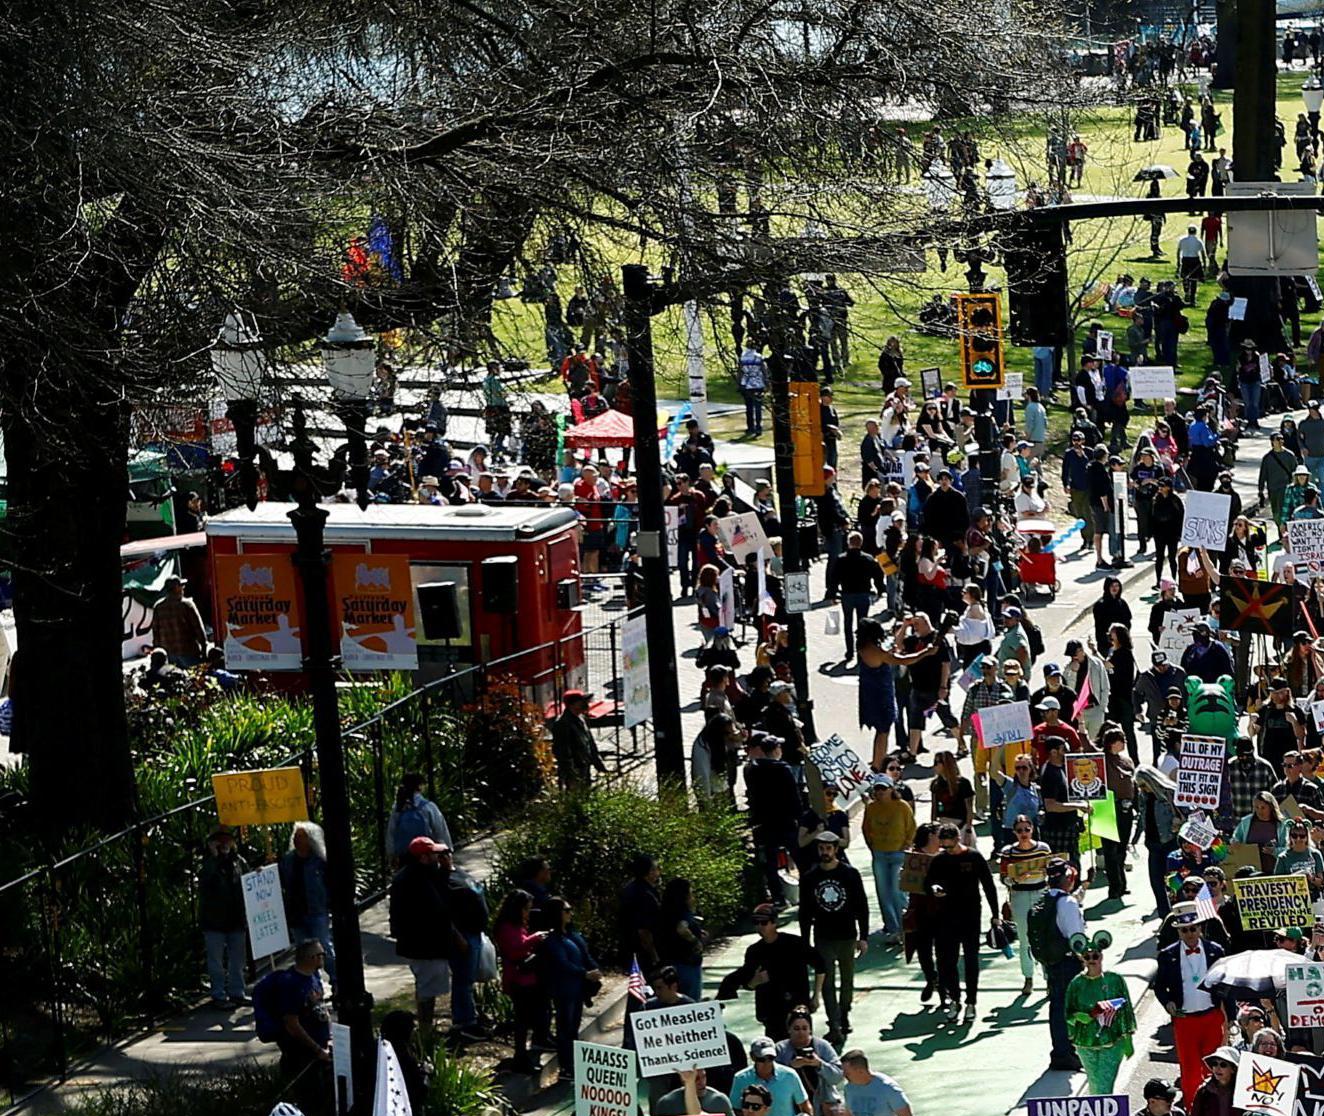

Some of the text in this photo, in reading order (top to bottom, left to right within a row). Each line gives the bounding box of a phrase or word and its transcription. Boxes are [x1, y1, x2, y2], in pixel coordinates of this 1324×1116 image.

[1183, 743, 1223, 757] ALL OF MY
[1181, 758, 1222, 771] OUTRAGE
[1180, 772, 1219, 784] CAN'T FIT ON
[1179, 782, 1218, 796] THIS SIGN
[636, 1007, 715, 1031] Got Measles?
[644, 1026, 717, 1048] Me Neither!
[581, 1047, 628, 1069] YAAASSS
[641, 1044, 726, 1068] Thanks, Science!
[586, 1067, 627, 1087] QUEEN!
[582, 1085, 631, 1106] NOOOOO
